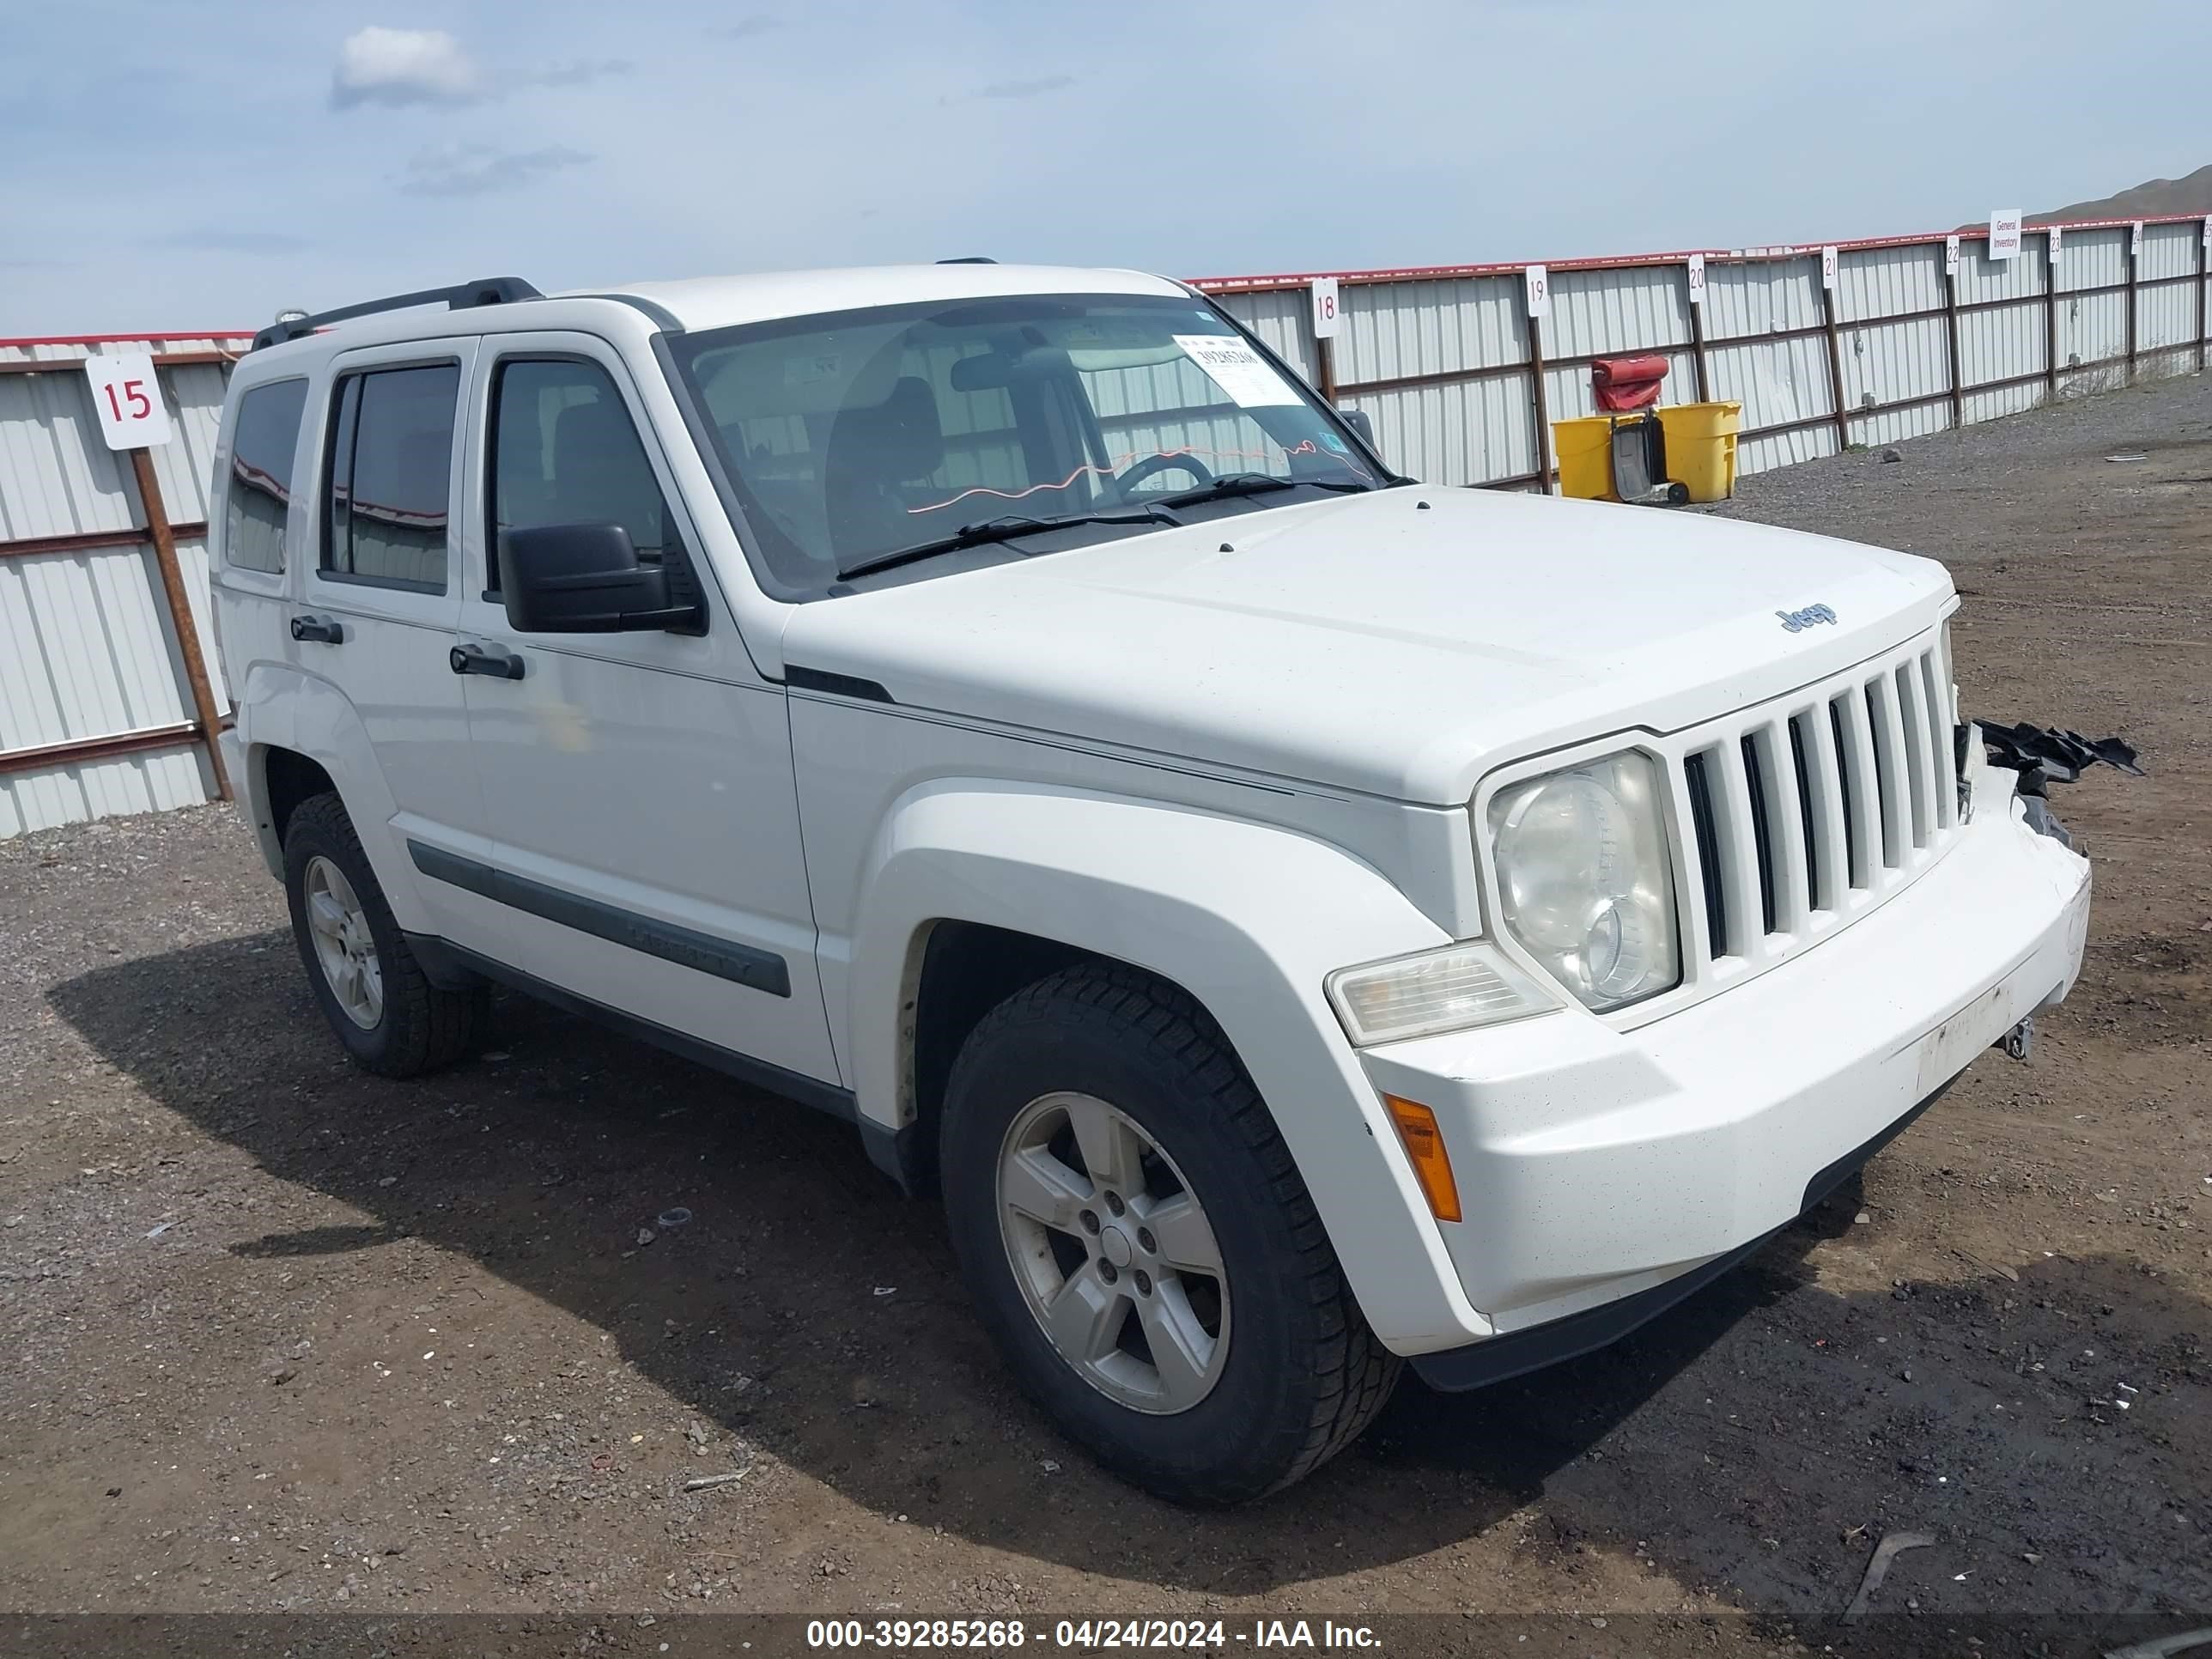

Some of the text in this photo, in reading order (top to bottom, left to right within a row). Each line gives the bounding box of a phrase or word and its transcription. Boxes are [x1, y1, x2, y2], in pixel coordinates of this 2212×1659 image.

[1997, 220, 2016, 231] General
[1994, 237, 2018, 249] Inventory
[2051, 237, 2060, 252] 23
[2133, 230, 2142, 245] 24
[1948, 246, 1959, 263] 22
[1825, 258, 1836, 276] 21
[1690, 268, 1705, 289] 20
[1531, 281, 1544, 302] 19
[1318, 296, 1334, 320] 18
[1197, 350, 1258, 365] 39285268
[105, 380, 151, 422] 15
[1774, 603, 1838, 633] Jeep
